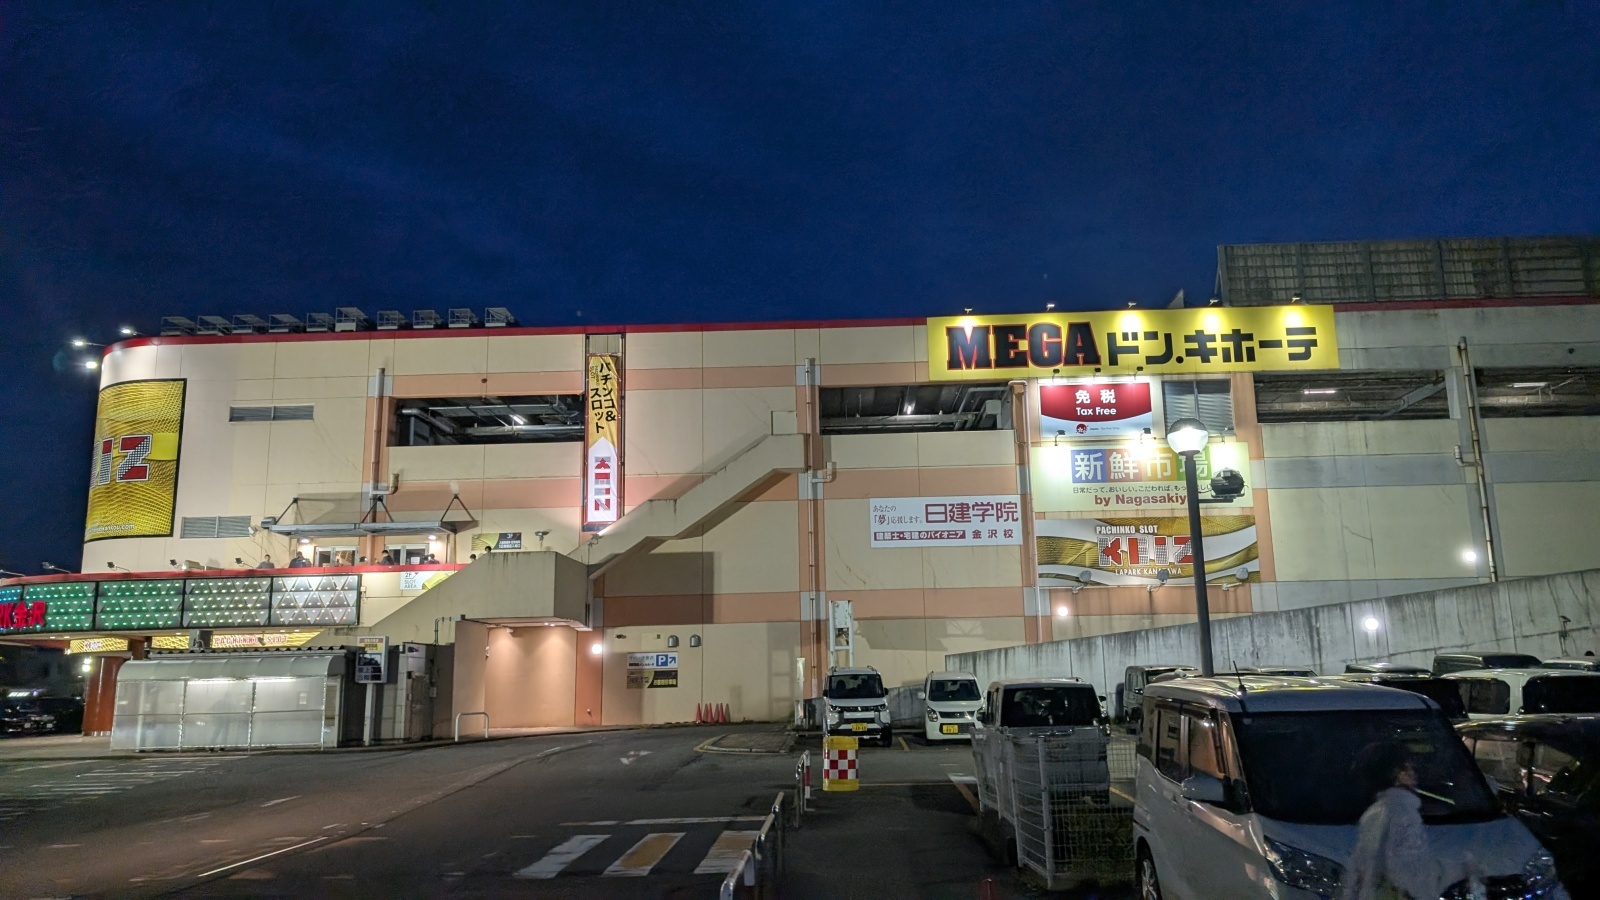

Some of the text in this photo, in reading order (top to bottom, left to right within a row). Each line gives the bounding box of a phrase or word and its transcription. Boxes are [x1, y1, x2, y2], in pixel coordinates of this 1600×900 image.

[946, 321, 1102, 370] MEGA
[1075, 389, 1116, 404] 免税
[590, 388, 604, 433] スロット
[1076, 407, 1117, 415] Tax Free
[1095, 494, 1111, 506] by
[925, 501, 1019, 523] 日建学院
[972, 529, 1014, 539] 金沢校
[1096, 525, 1158, 534] PACHINKO SLOT
[658, 655, 666, 666] P
